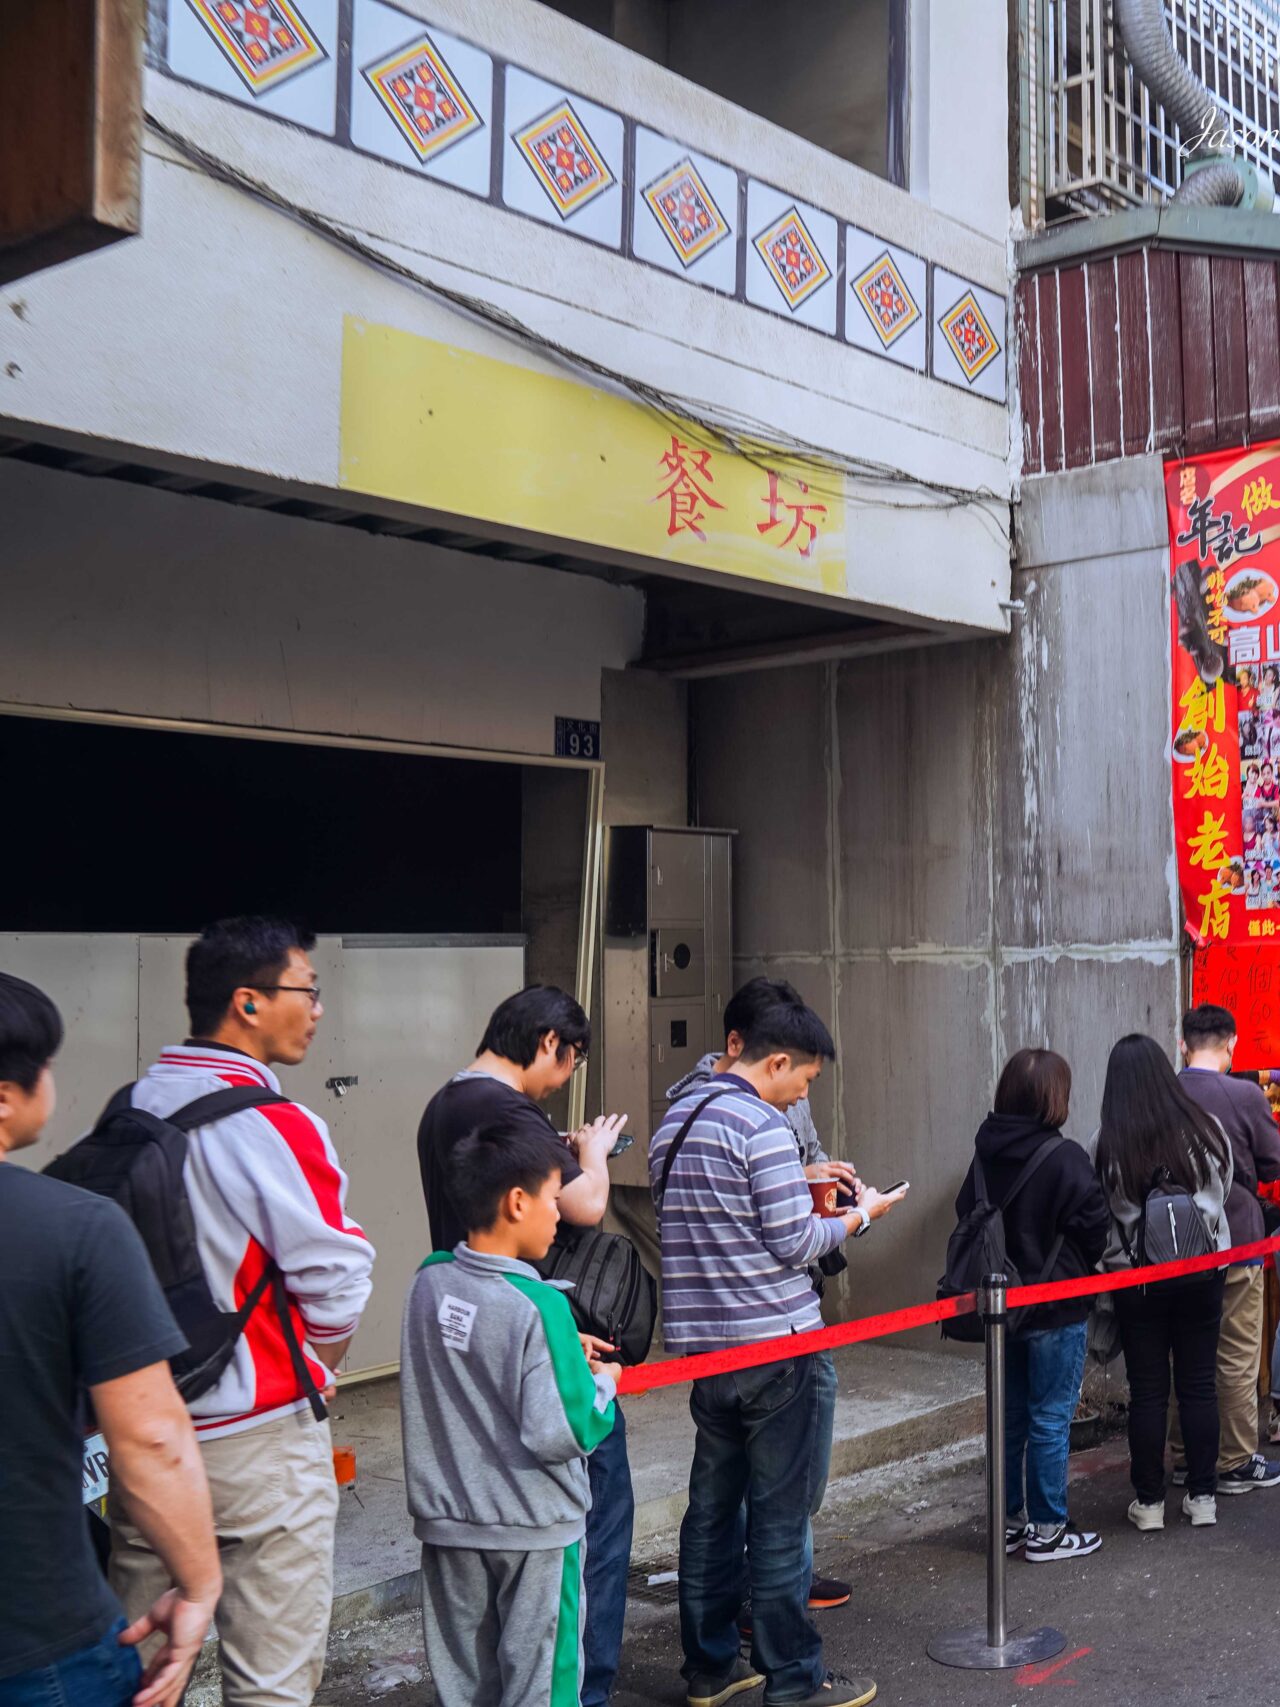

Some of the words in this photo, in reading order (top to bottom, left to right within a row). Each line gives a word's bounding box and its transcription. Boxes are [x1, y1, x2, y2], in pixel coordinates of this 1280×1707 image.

[652, 435, 827, 557] 餐坊
[1178, 496, 1263, 565] 年記
[570, 733, 593, 757] 93
[1178, 675, 1231, 939] 創始老店
